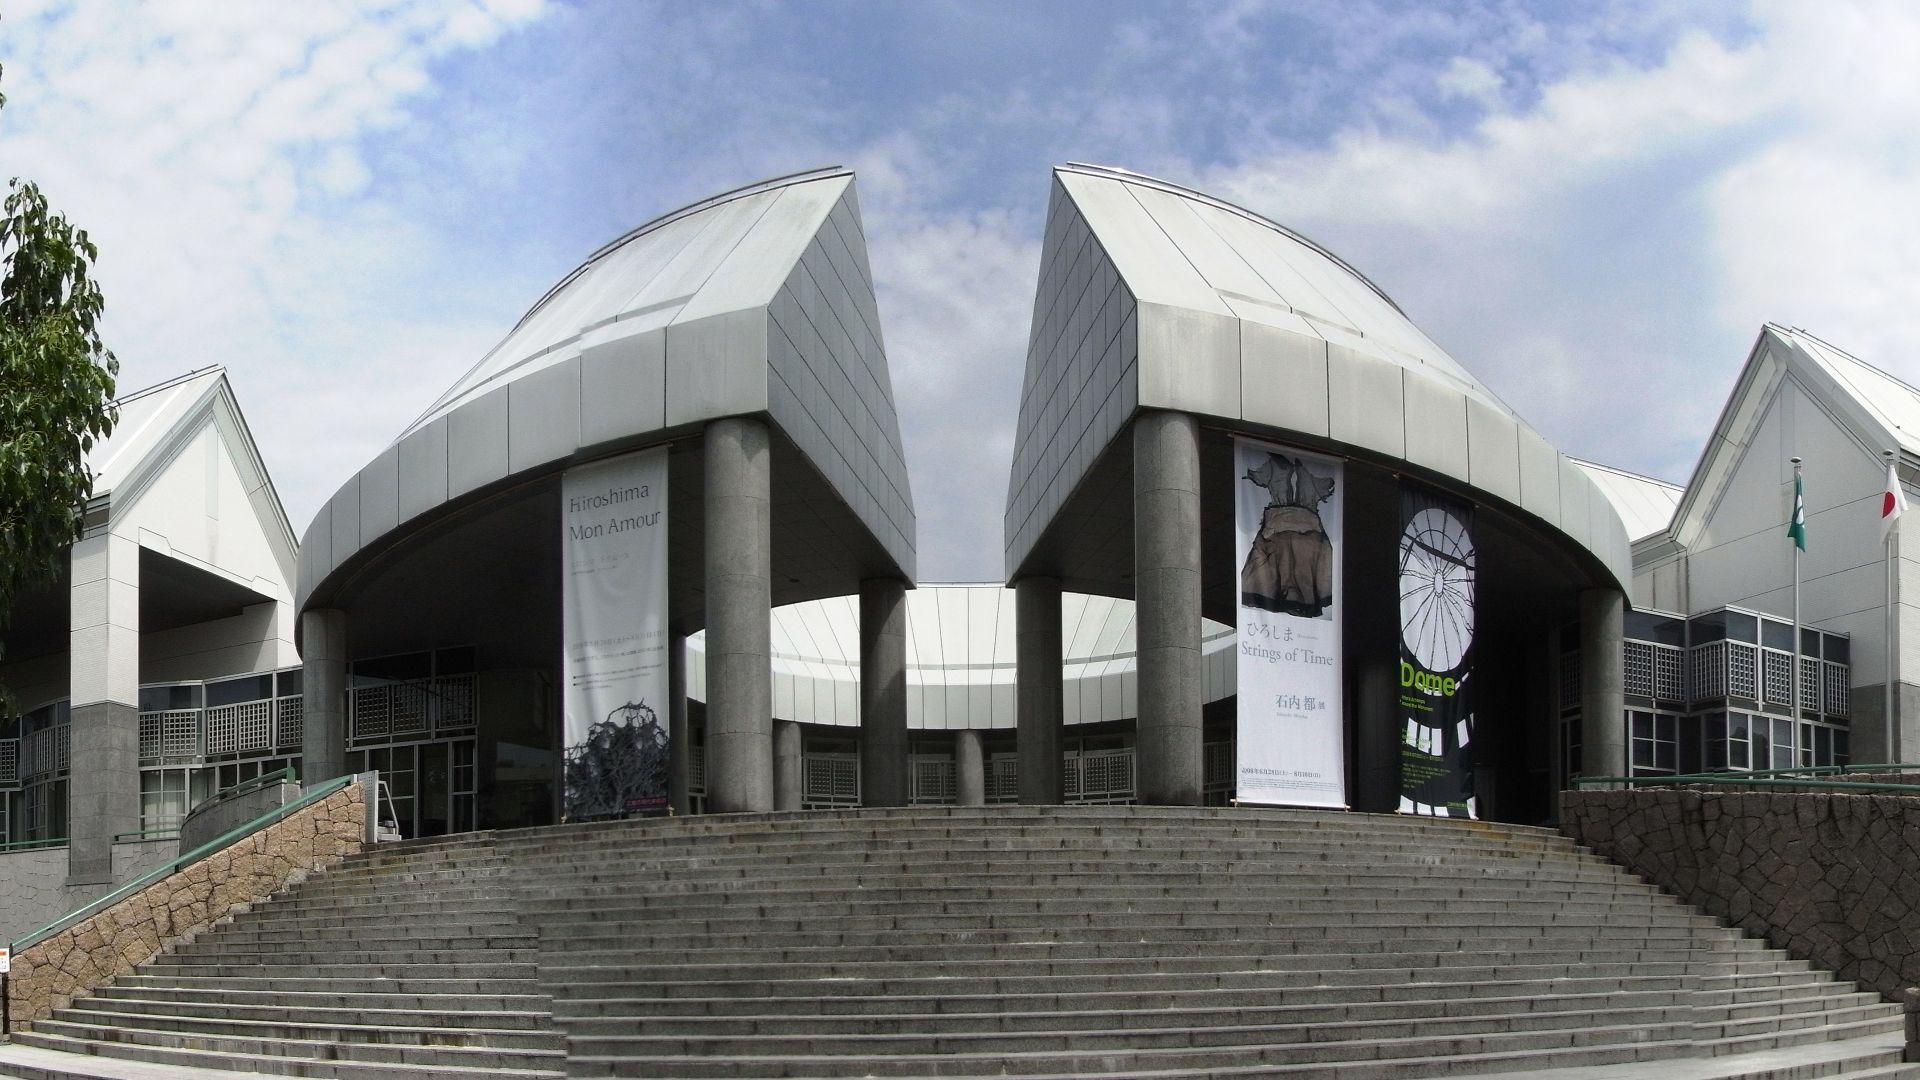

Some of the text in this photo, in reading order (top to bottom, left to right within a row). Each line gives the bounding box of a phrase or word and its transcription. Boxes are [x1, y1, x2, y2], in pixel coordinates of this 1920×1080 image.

[570, 485, 649, 513] Hiroshima
[570, 511, 661, 541] Mon Amour
[1247, 622, 1294, 642] ひろしま
[1241, 641, 1333, 666] Strings of Time
[1401, 662, 1455, 696] Dome
